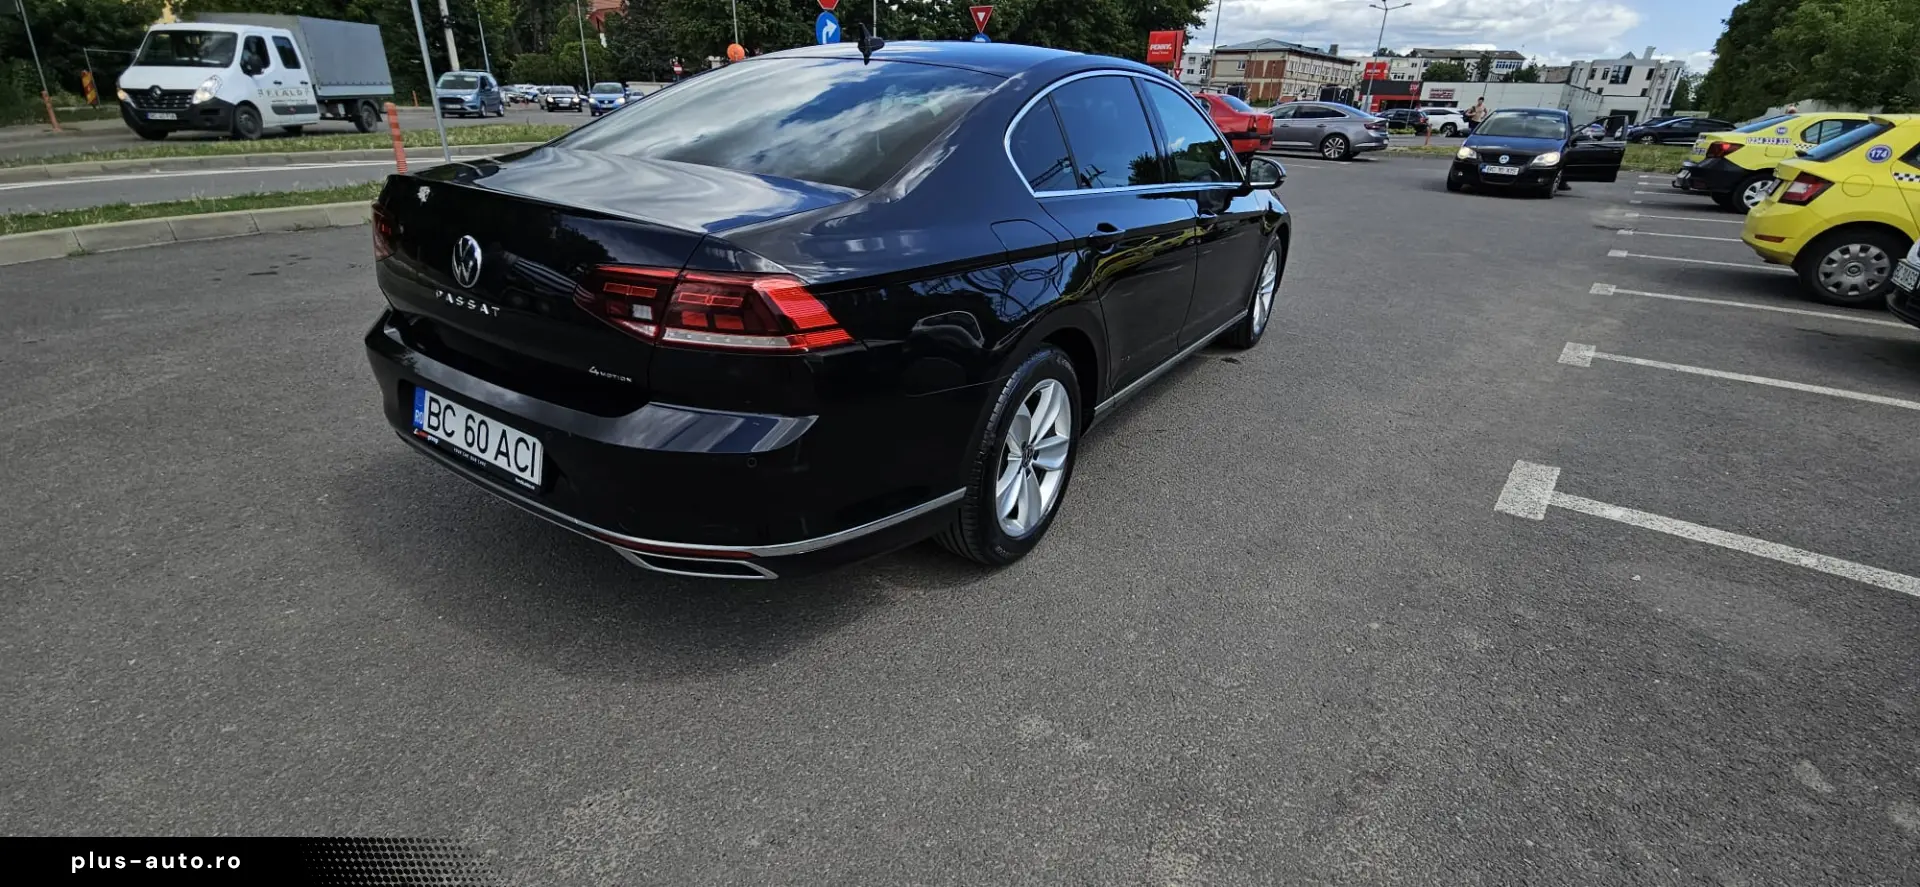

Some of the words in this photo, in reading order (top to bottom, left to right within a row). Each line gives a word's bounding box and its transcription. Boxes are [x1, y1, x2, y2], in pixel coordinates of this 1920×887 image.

[1870, 149, 1887, 159] 174
[435, 289, 500, 317] PASSAT
[414, 409, 424, 425] RO
[427, 396, 456, 438] BC
[464, 413, 489, 454] 60
[494, 428, 537, 478] ACI
